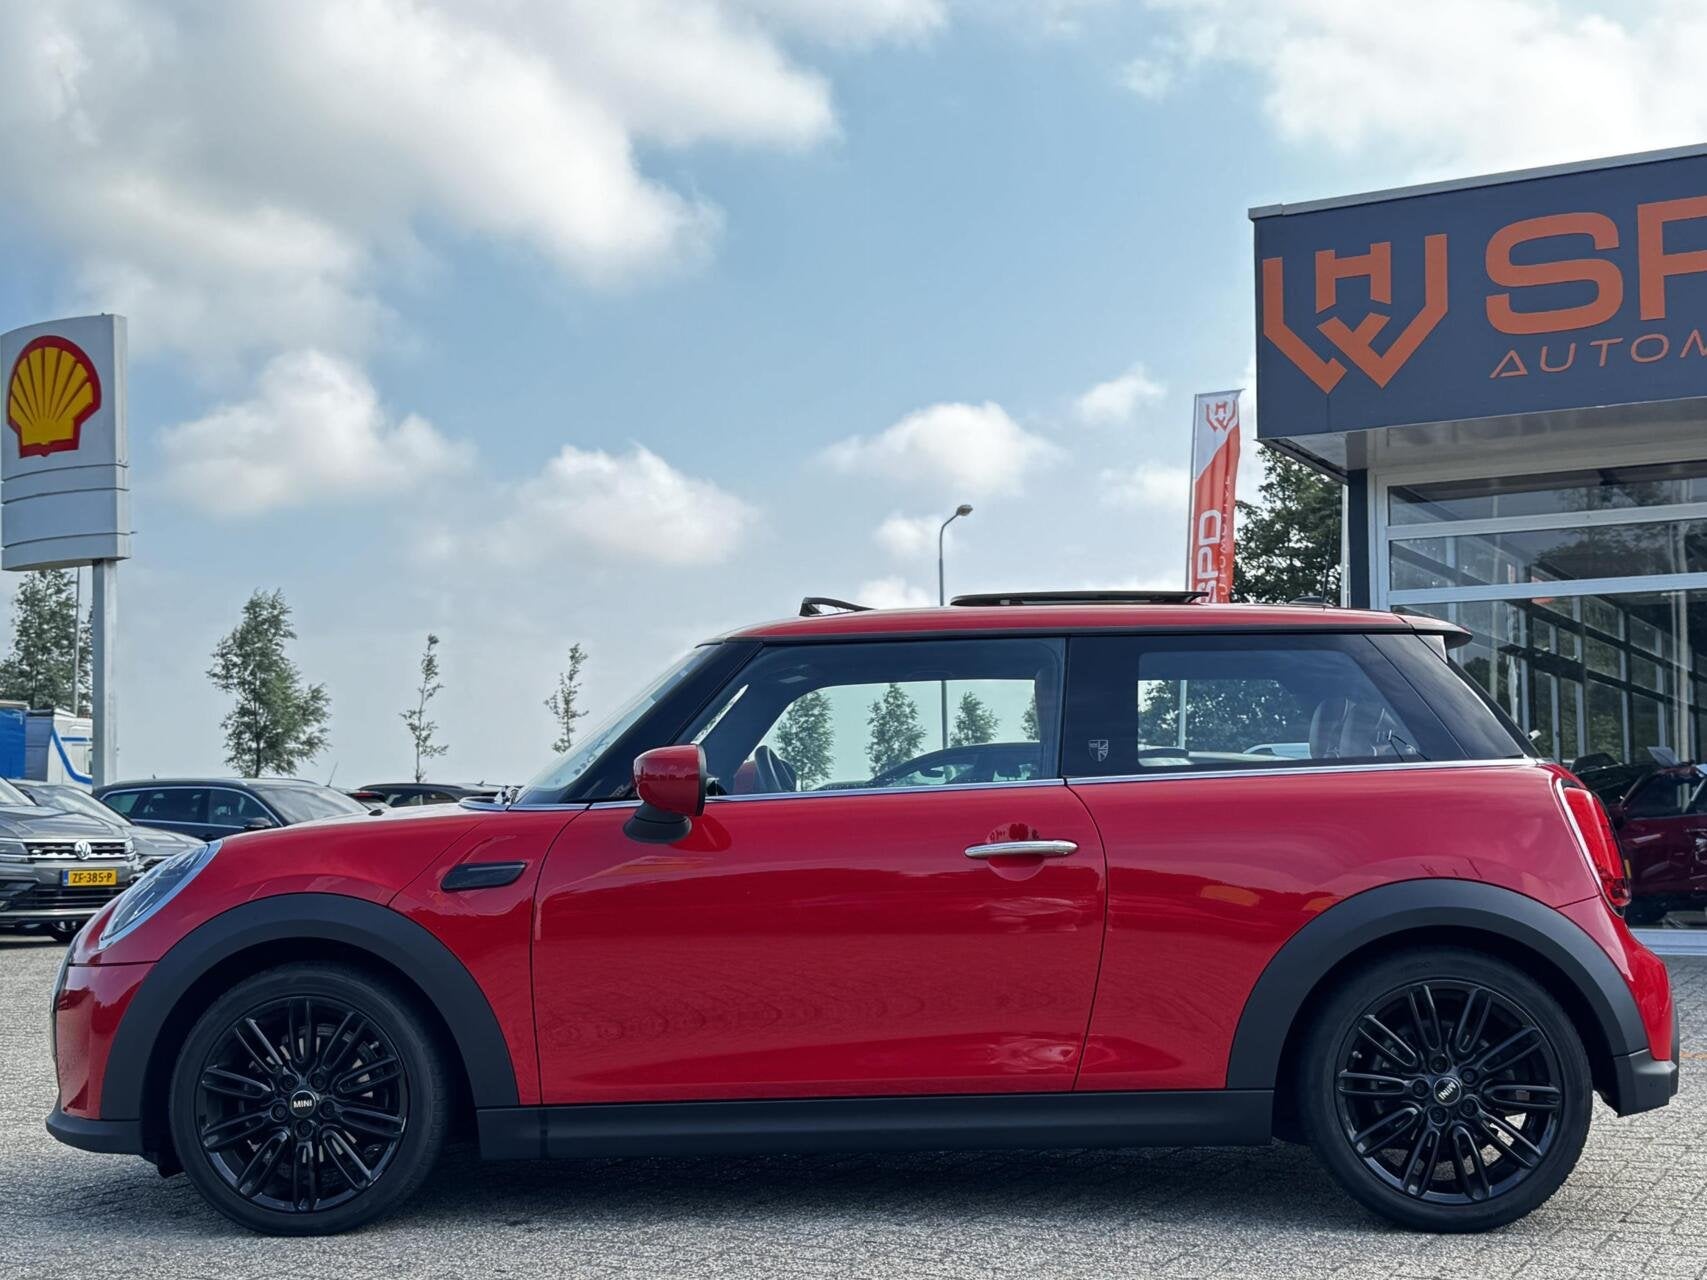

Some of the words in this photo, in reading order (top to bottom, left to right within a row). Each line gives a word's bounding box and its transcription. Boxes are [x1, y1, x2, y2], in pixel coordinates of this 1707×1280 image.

[72, 872, 113, 883] ZF-385-P
[1438, 1081, 1456, 1100] MINI
[293, 1099, 313, 1108] MINI
